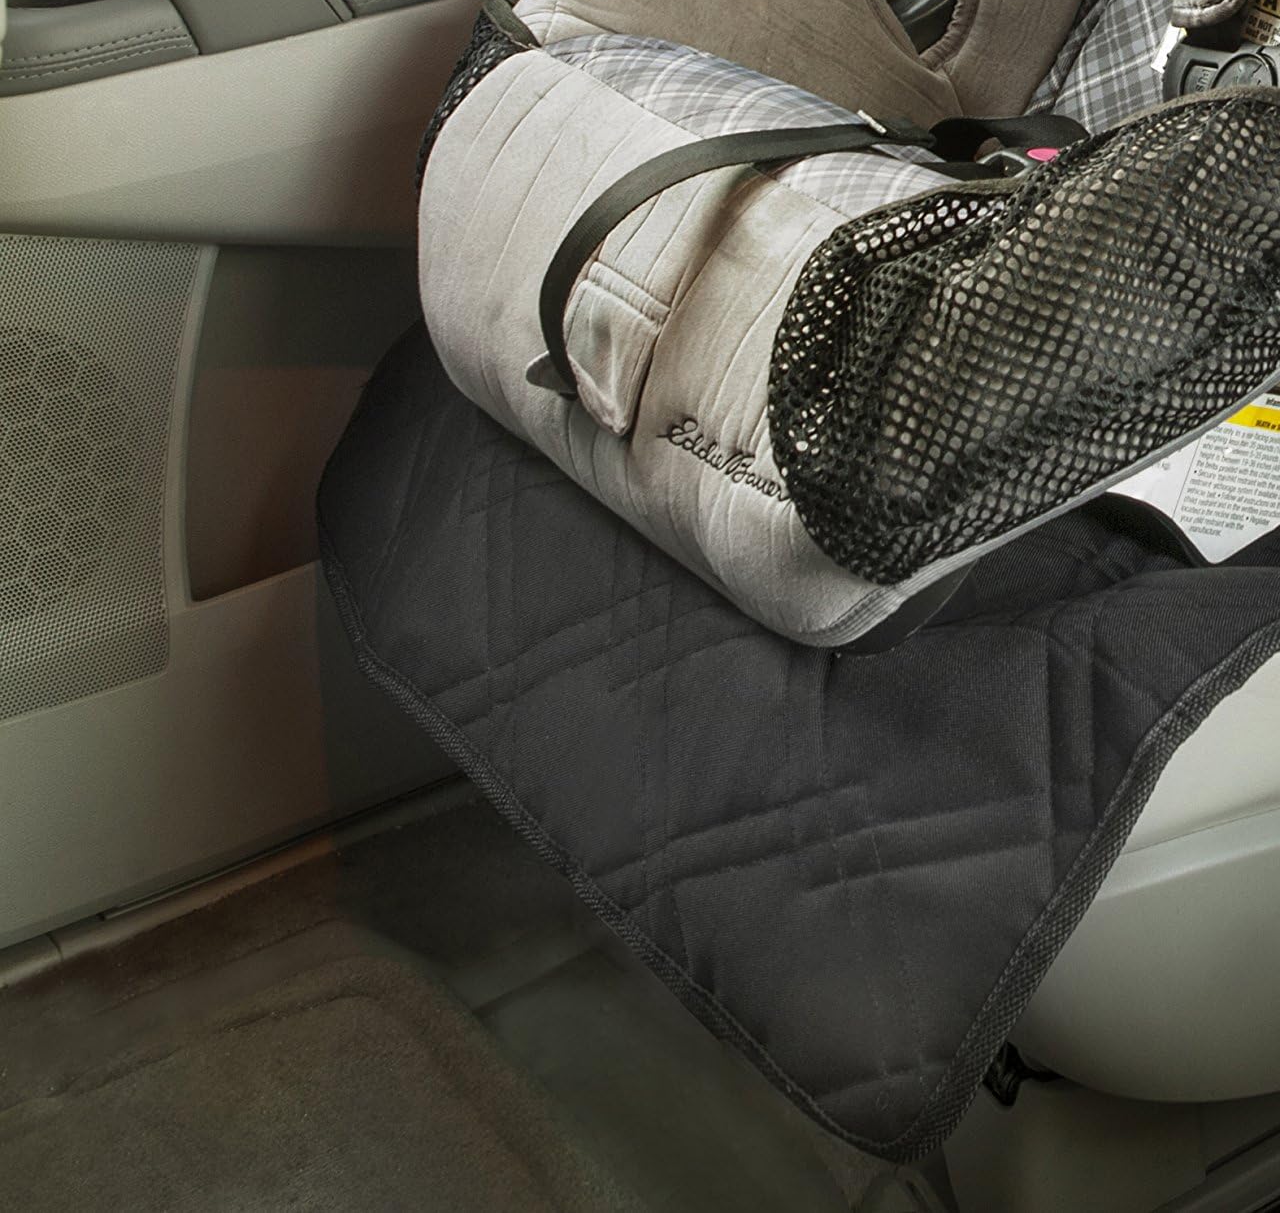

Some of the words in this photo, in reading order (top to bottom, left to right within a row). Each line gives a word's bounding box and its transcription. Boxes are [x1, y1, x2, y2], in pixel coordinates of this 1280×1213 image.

[1258, 19, 1273, 33] NOT
[656, 418, 724, 470] Eddie
[722, 450, 794, 502] Bauer
